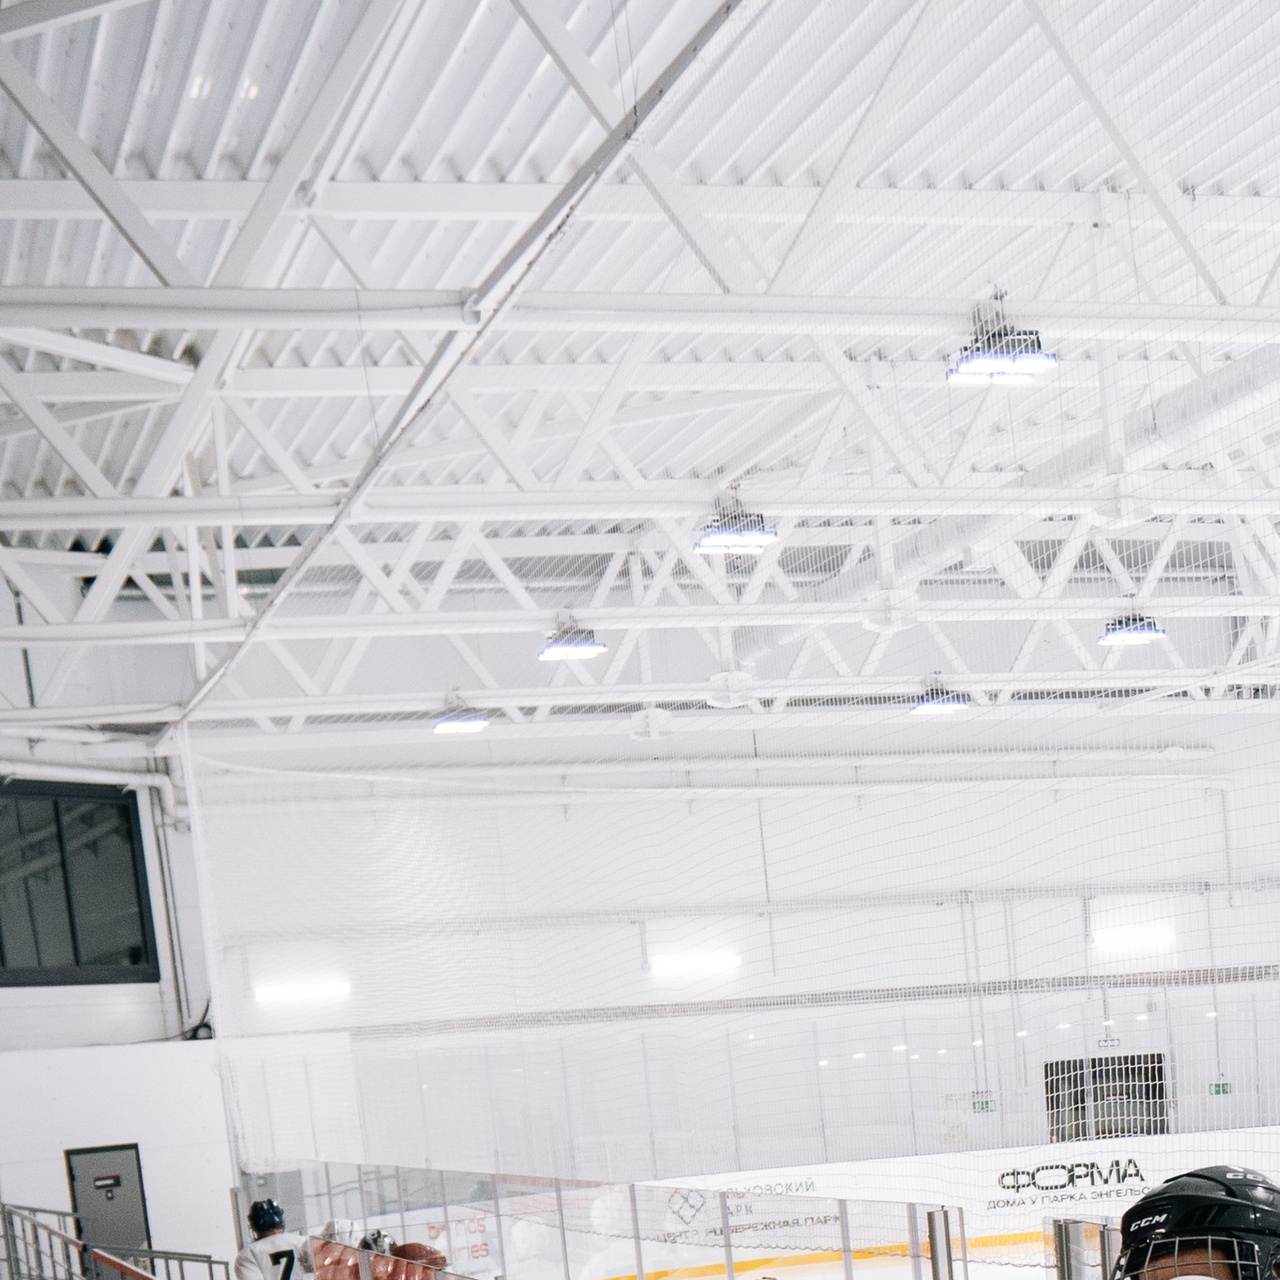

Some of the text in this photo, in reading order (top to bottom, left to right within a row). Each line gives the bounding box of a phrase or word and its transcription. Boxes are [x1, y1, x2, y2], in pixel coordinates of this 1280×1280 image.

[998, 1158, 1145, 1193] ФОРМА
[986, 1199, 1026, 1211] ДОМА
[1041, 1191, 1087, 1205] ПАРКА
[1090, 1186, 1152, 1200] ЭНГЕЛЬС
[1129, 1213, 1168, 1232] CCM
